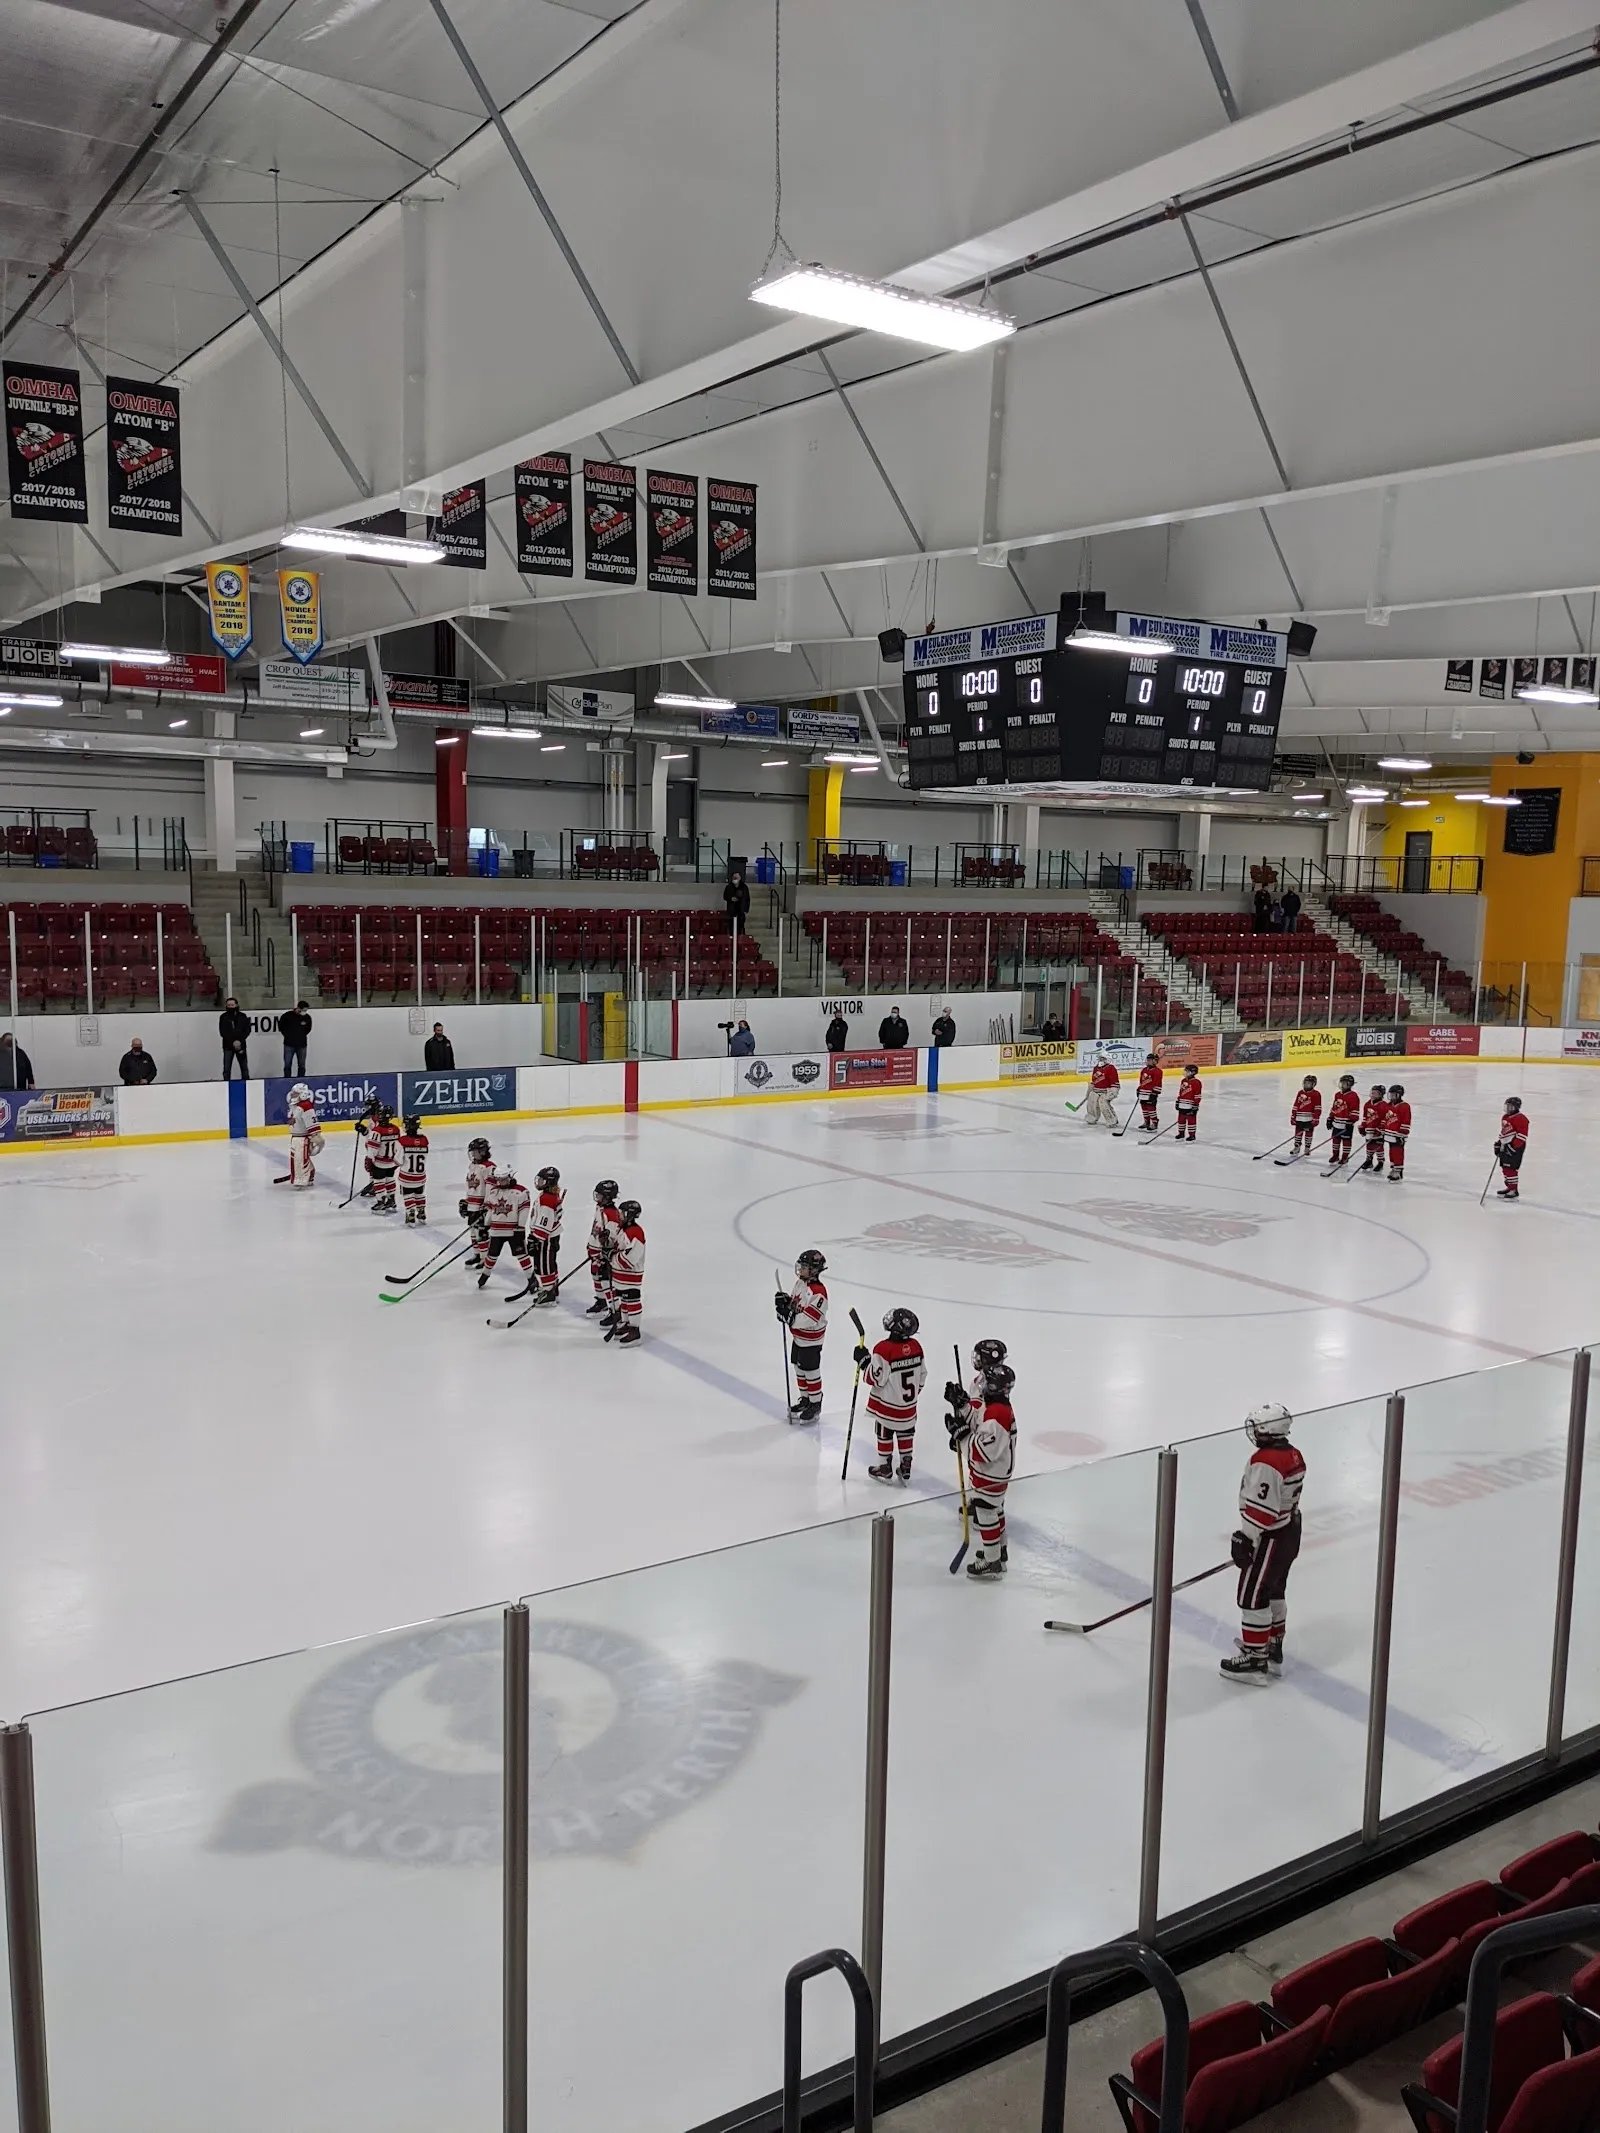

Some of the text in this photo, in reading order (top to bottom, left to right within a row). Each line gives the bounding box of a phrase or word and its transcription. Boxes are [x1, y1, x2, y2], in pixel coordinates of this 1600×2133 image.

[7, 376, 78, 402] OMHA
[8, 397, 51, 413] JUVENILE
[109, 391, 177, 419] OMHA
[114, 412, 152, 429] ATOM
[29, 449, 77, 478] CYCLONES
[128, 465, 174, 491] CYCLONES
[585, 463, 635, 484] OMHA
[518, 475, 548, 487] ATOM
[586, 481, 617, 495] BANTAM
[649, 476, 696, 496] OMHA
[22, 482, 75, 496] 2017/2018
[709, 484, 754, 503] OMHA
[13, 494, 85, 510] CHAMPIONS
[119, 495, 170, 509] 2017/2018
[651, 494, 694, 508] NOVICE REP
[711, 501, 741, 514] BANTAM
[111, 506, 179, 524] CHAMPIONS
[442, 503, 481, 528] CYCLONES
[531, 516, 567, 541] CYCLONES
[435, 533, 478, 545] 2015/2016
[597, 525, 632, 549] CYCLONES
[442, 546, 485, 558] AMPIONS
[526, 545, 565, 555] 2013/2014
[520, 554, 571, 567] CHAMPIONS
[592, 552, 629, 564] 2012/2013
[587, 562, 636, 575] CHAMPIONS
[658, 566, 688, 575] 2012/2013
[716, 569, 749, 579] 2011/2012
[649, 573, 696, 586] CHAMPIONS
[710, 578, 755, 590] CHAMPIONS
[220, 621, 243, 629] 2018
[1130, 617, 1200, 638] MEULENSTEEN
[981, 619, 1046, 650] MEULENSTEEN
[1211, 628, 1277, 651] MEULENSTEEN
[2, 639, 36, 647] CRABBY
[913, 632, 972, 660] MEULENSTEEN
[1001, 646, 1018, 654] AUTO
[1019, 642, 1045, 652] SERVICE
[932, 657, 946, 665] AUTO
[948, 653, 971, 663] SERVICE
[1210, 650, 1224, 658] TIRE
[1232, 653, 1249, 661] AUTO
[1250, 656, 1276, 665] SERVICE
[158, 666, 193, 674] PLUMBING
[266, 665, 291, 674] CROP
[293, 667, 323, 677] QUEST
[1015, 658, 1042, 675] GUEST
[1130, 657, 1158, 674] HOME
[916, 673, 938, 689] HOME
[962, 669, 998, 696] 10:00
[1182, 668, 1225, 695] 10:00
[1244, 669, 1272, 686] GUEST
[1030, 678, 1041, 703] 0
[1139, 678, 1153, 703] 0
[929, 692, 938, 715] 0
[967, 701, 988, 712] PERIOD
[1187, 699, 1210, 711] PERIOD
[1252, 690, 1266, 714] 0
[792, 711, 819, 720] GORD'S
[1007, 713, 1056, 727] PLYR PENALTY
[1110, 712, 1164, 726] PLYR PENALTY
[910, 724, 951, 737] PLYR PENALTY
[978, 717, 983, 732] 1
[1194, 716, 1200, 731] 1
[1226, 722, 1275, 735] PLYR PENALTY
[959, 739, 1001, 751] SHOTS ON GOAL
[1168, 738, 1216, 751] SHOTS ON GOAL
[976, 777, 988, 785] OES
[1180, 777, 1194, 785] OES
[821, 1001, 863, 1014] VISITOR
[1288, 1034, 1316, 1048] Weed
[1318, 1034, 1342, 1046] Man
[1015, 1042, 1075, 1057] WATSON'S
[853, 1058, 887, 1068] Elma Steel
[795, 1066, 817, 1075] 1959
[413, 1077, 493, 1105] ZEHR
[59, 1100, 91, 1110] Dealer
[333, 1108, 342, 1116] tv
[28, 1114, 48, 1124] USED
[50, 1112, 81, 1123] TRUCKS
[76, 1130, 114, 1138] stop23.com
[408, 1154, 425, 1173] 16
[540, 1217, 548, 1226] 18
[816, 1299, 823, 1309] 8
[874, 1366, 882, 1377] 5
[901, 1370, 915, 1402] 5
[1258, 1482, 1270, 1500] 3
[318, 1810, 604, 1866] NORH
[616, 1705, 753, 1820] PERTH
